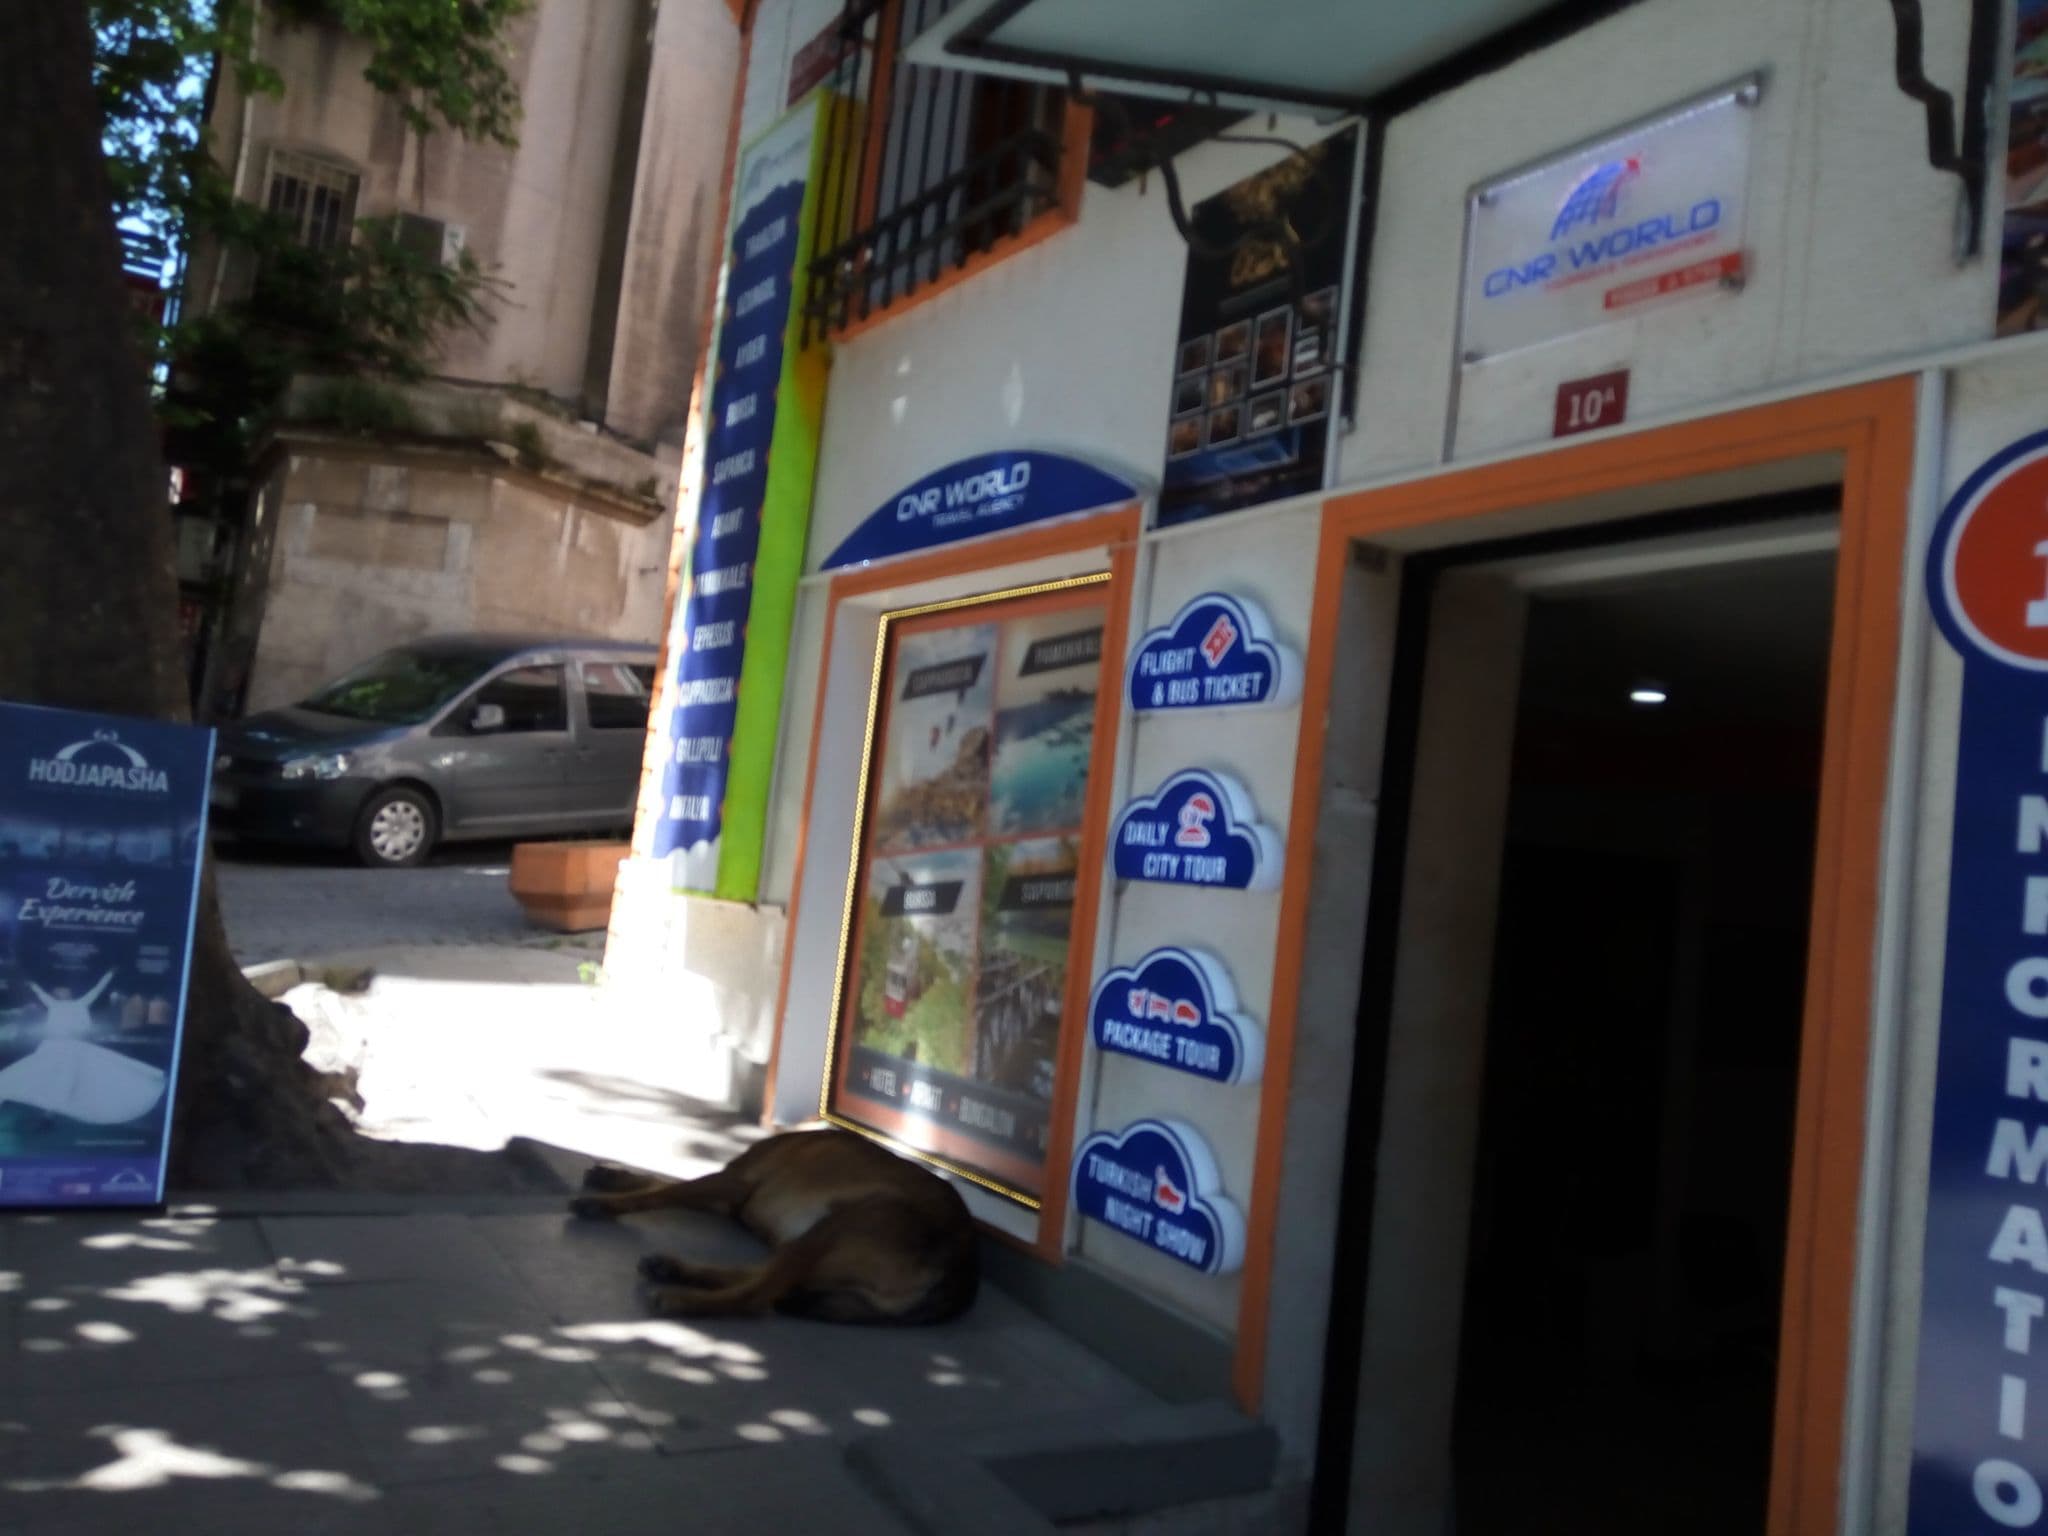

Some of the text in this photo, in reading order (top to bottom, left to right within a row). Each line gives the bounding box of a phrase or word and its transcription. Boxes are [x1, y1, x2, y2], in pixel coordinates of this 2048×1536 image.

[1483, 254, 1556, 299] CNR
[1570, 198, 1721, 269] WORLD
[897, 461, 1031, 522] CNR WORLD
[692, 620, 735, 652] EPHESUS
[1140, 648, 1196, 677] FLIGHT
[1152, 672, 1265, 706] & BUS TICKET
[29, 758, 168, 792] HODJAPASHA
[1123, 820, 1170, 847] DAILY
[1143, 853, 1228, 883] CITY TOUR
[46, 876, 136, 902] Dervish
[18, 898, 145, 926] Experience
[1103, 1019, 1221, 1073] PACKAGE TOUR
[1088, 1153, 1153, 1202] TURKISH
[1104, 1196, 1207, 1265] NIGHT SHOW
